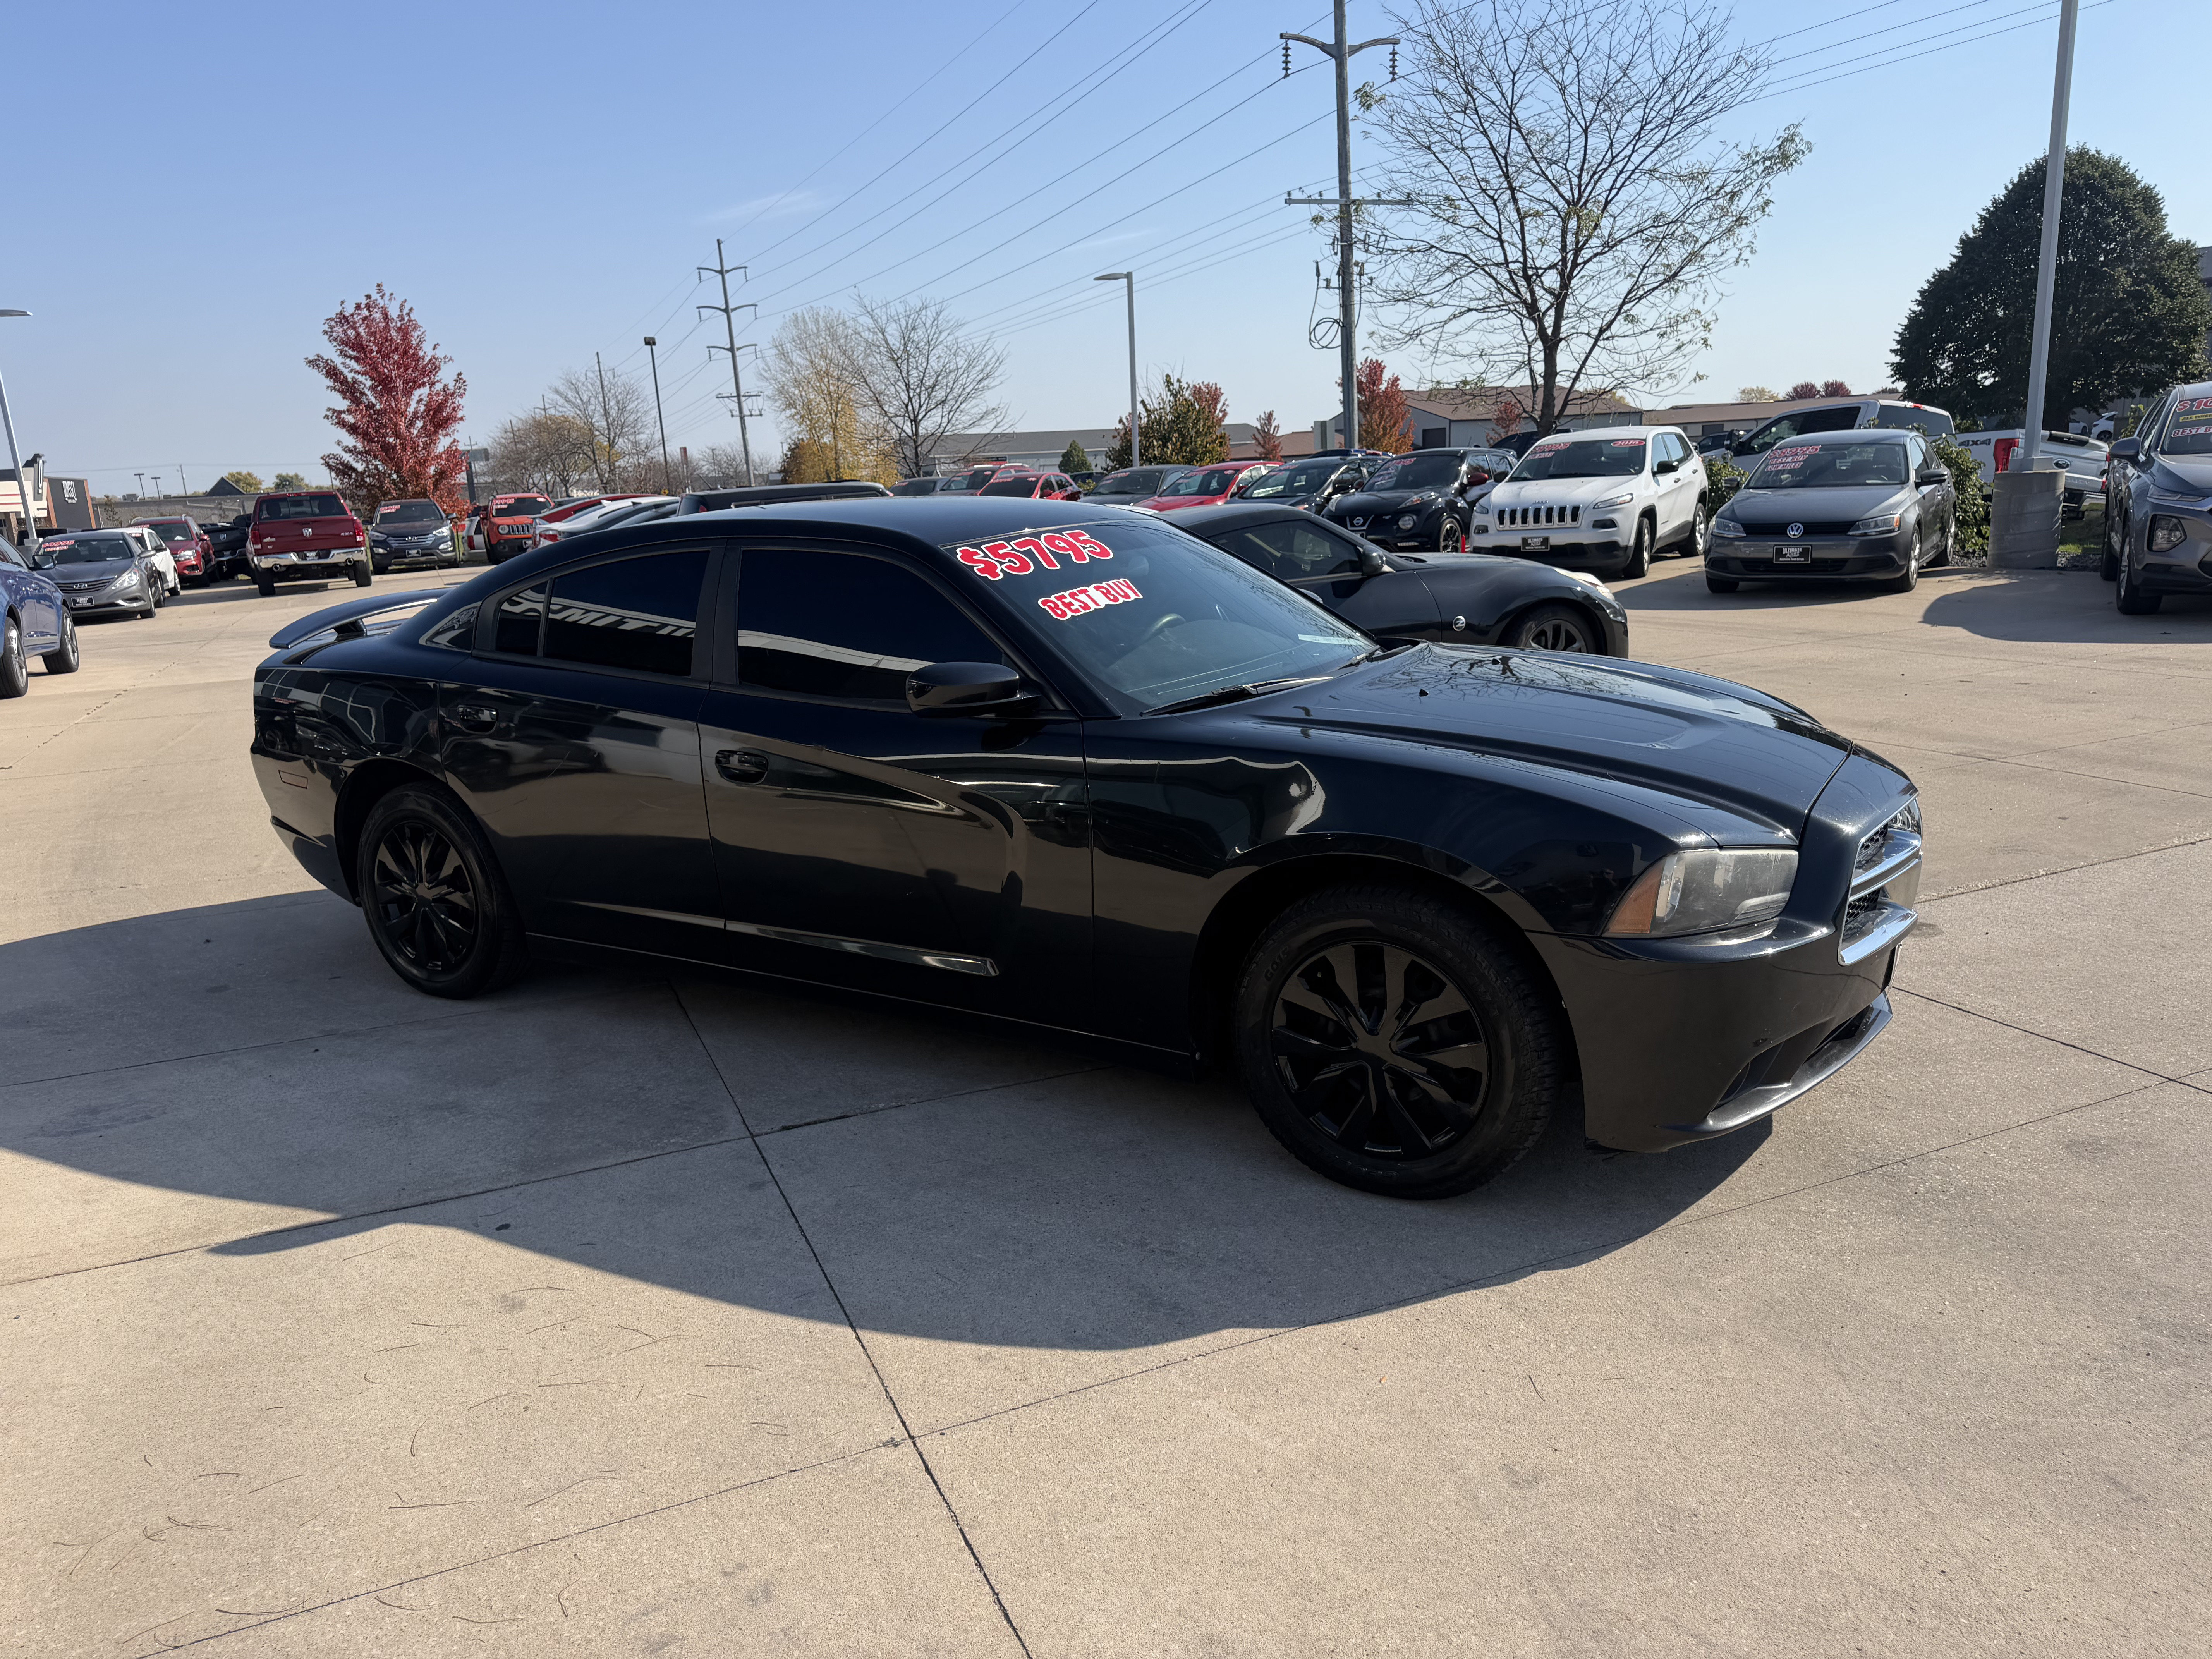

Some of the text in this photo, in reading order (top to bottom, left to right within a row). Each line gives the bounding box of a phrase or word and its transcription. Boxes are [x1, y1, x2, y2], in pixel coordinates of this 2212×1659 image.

[2172, 427, 2202, 437] BEST
[957, 530, 1113, 580] $5795
[1039, 579, 1142, 620] BEST BUY
